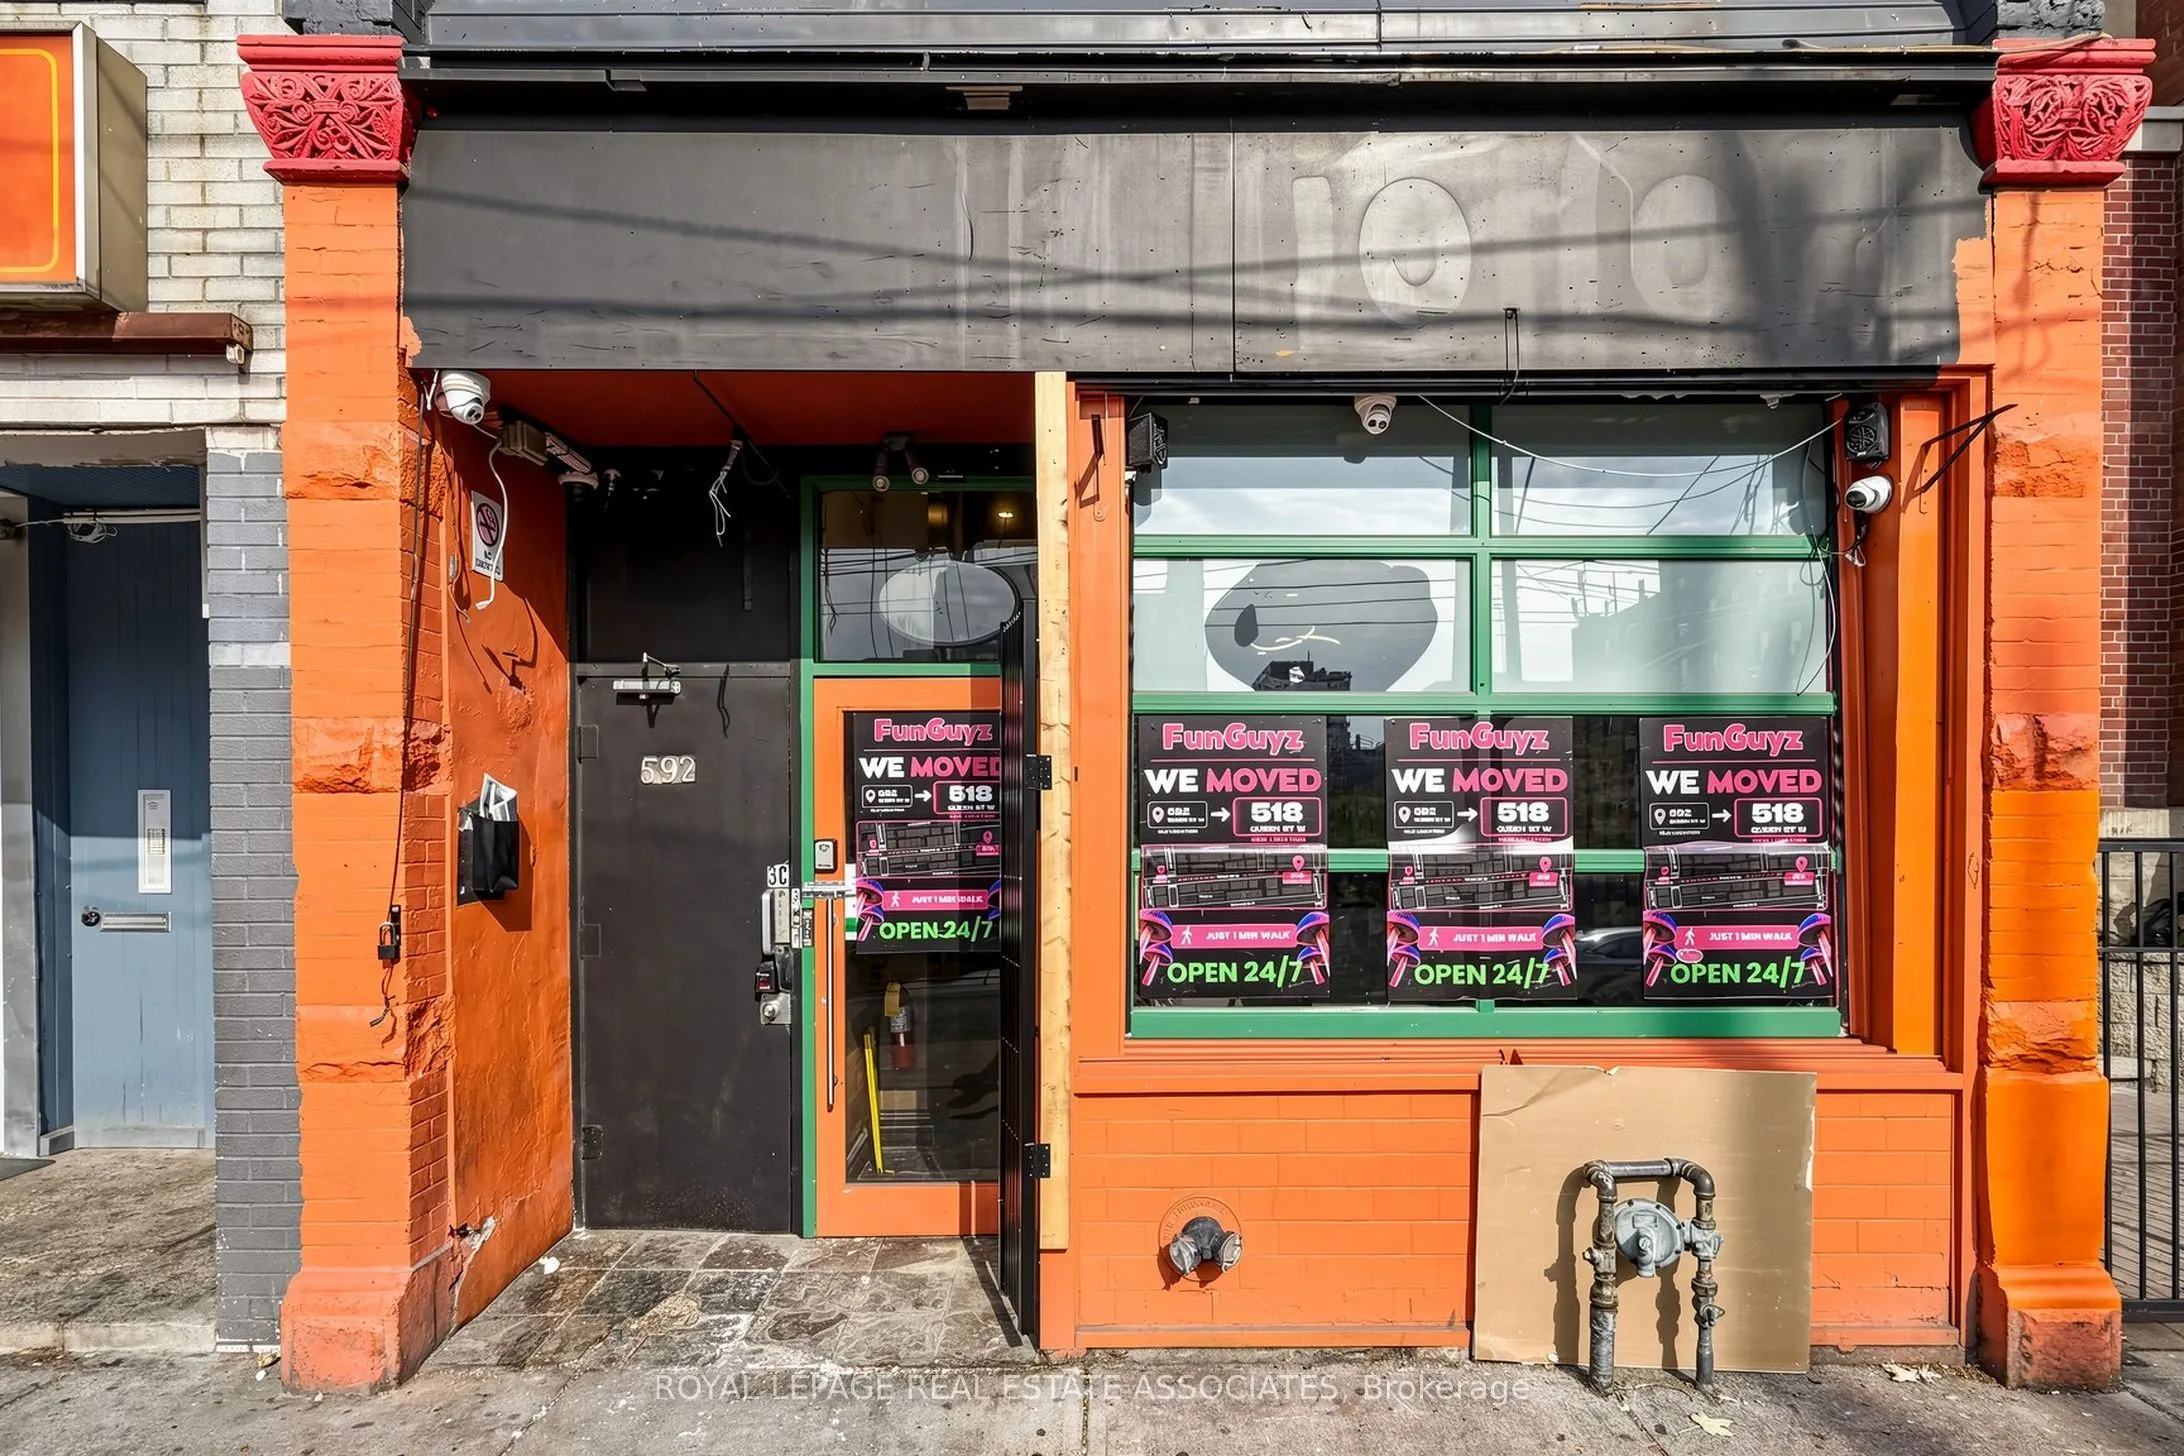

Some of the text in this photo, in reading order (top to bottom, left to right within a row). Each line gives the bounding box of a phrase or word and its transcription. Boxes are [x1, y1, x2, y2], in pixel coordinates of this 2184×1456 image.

[874, 717, 993, 747] FunGuyz
[1162, 722, 1304, 756] FunGuyz
[1409, 721, 1549, 756] FunGuyz
[1663, 723, 1804, 757] FunGuyz
[640, 755, 696, 784] 592
[858, 756, 905, 779] WE
[1144, 767, 1322, 794] WE MOVED
[1391, 767, 1568, 793] WE MOVED
[949, 785, 993, 802] 518
[1645, 769, 1822, 795] WE MOVED
[1251, 801, 1304, 824] 518
[1497, 801, 1550, 823] 518
[1751, 803, 1804, 824] 518
[879, 915, 993, 942] OPEN 24/7
[1261, 930, 1291, 940] WALK
[1453, 933, 1478, 943] JUST
[1507, 932, 1536, 943] WALK
[1709, 932, 1733, 941] JUST
[1741, 932, 1761, 941] MIN
[1762, 932, 1793, 941] WALK
[1167, 955, 1303, 988] OPEN 24/7
[1414, 957, 1549, 989] OPEN 24/7
[1670, 956, 1806, 989] OPEN 24/7
